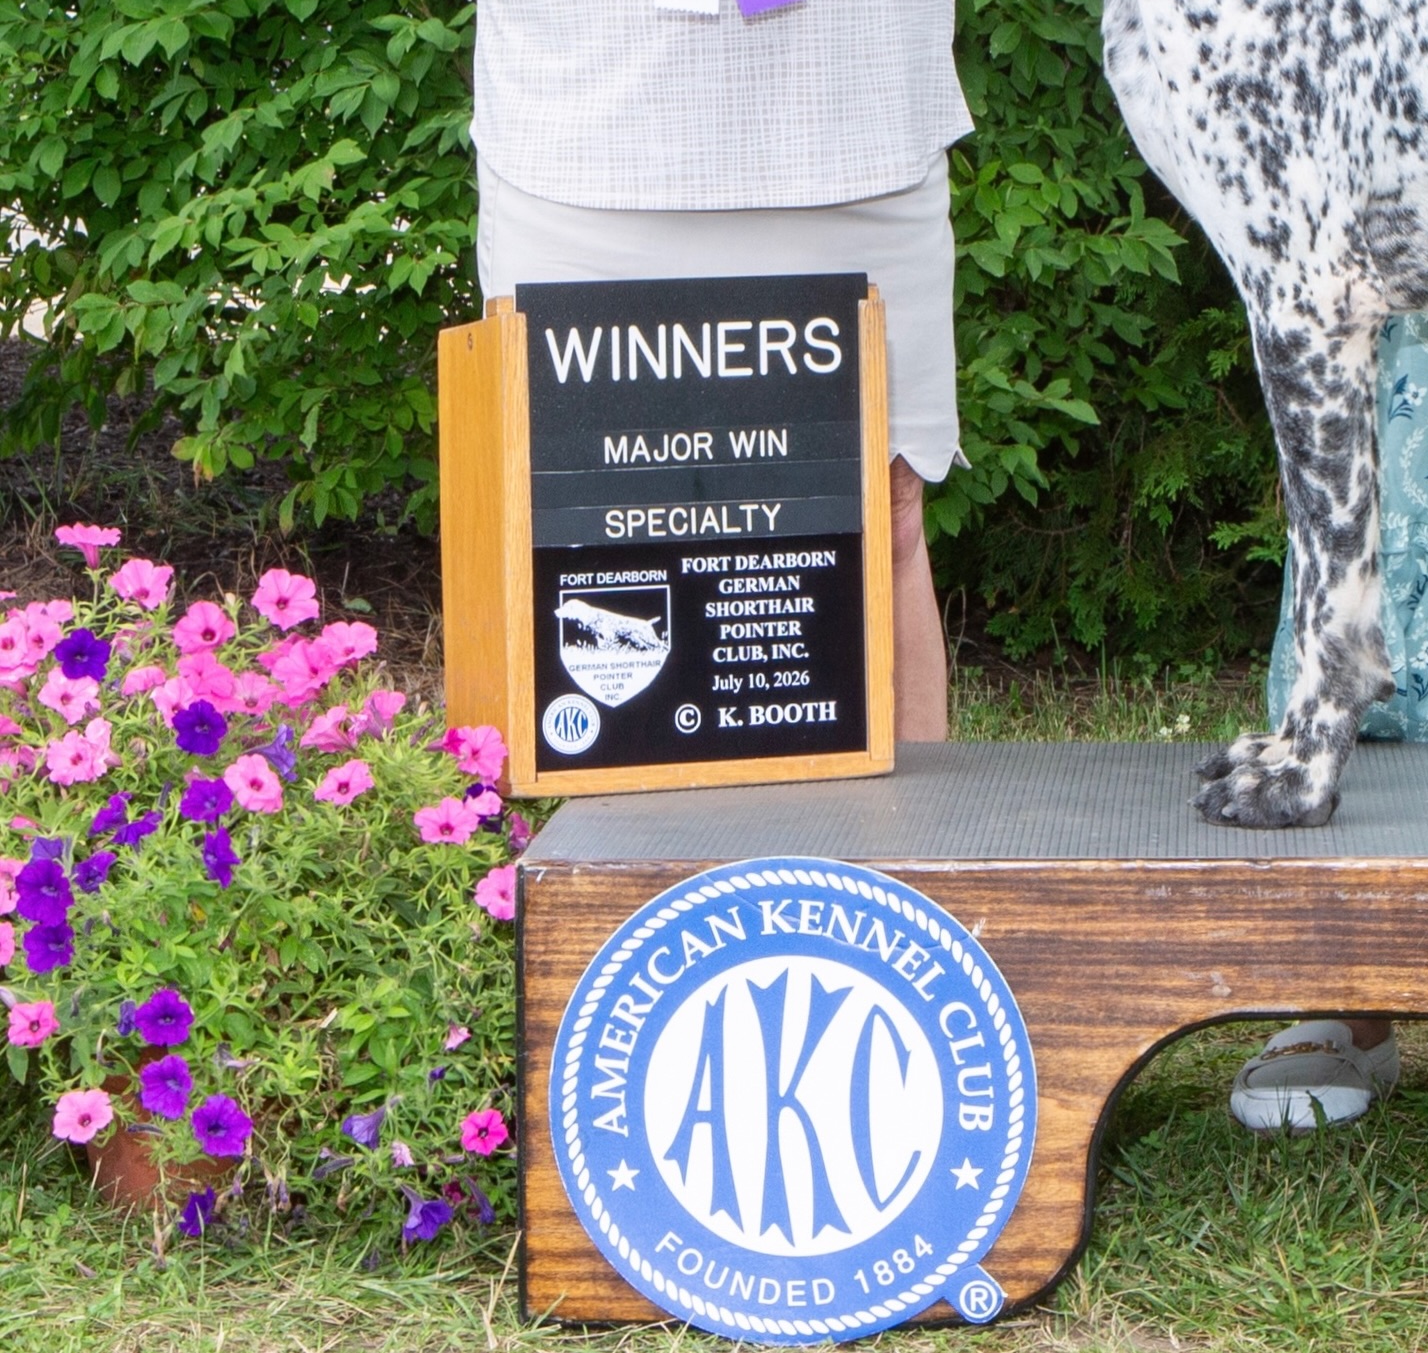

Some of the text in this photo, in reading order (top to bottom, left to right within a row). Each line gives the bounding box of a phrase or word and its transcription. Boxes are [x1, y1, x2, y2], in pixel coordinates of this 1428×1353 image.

[545, 317, 842, 384] WINNERS
[604, 428, 788, 464] MAJOR WIN
[605, 503, 781, 538] SPECIALTY
[681, 551, 836, 574] FORT DEARBORN
[560, 570, 668, 586] FORT DEARBORN
[718, 575, 800, 594] GERMAN
[705, 597, 815, 618] SHORTHAIR
[720, 620, 802, 640] POINTER
[712, 643, 809, 663] CLUB, INC.
[568, 659, 661, 672] GERMAN SHORTHAIR
[593, 672, 633, 681] POINTER
[600, 682, 624, 691] CLUB
[712, 670, 810, 694] July 10, 2026
[555, 707, 588, 742] AKC
[718, 707, 744, 728] K.
[748, 701, 837, 726] BOOTH
[591, 899, 994, 1137] AMERICAN KENNEL CLUB
[663, 966, 921, 1248] AKC
[655, 1229, 934, 1307] FOUNDED 1884
